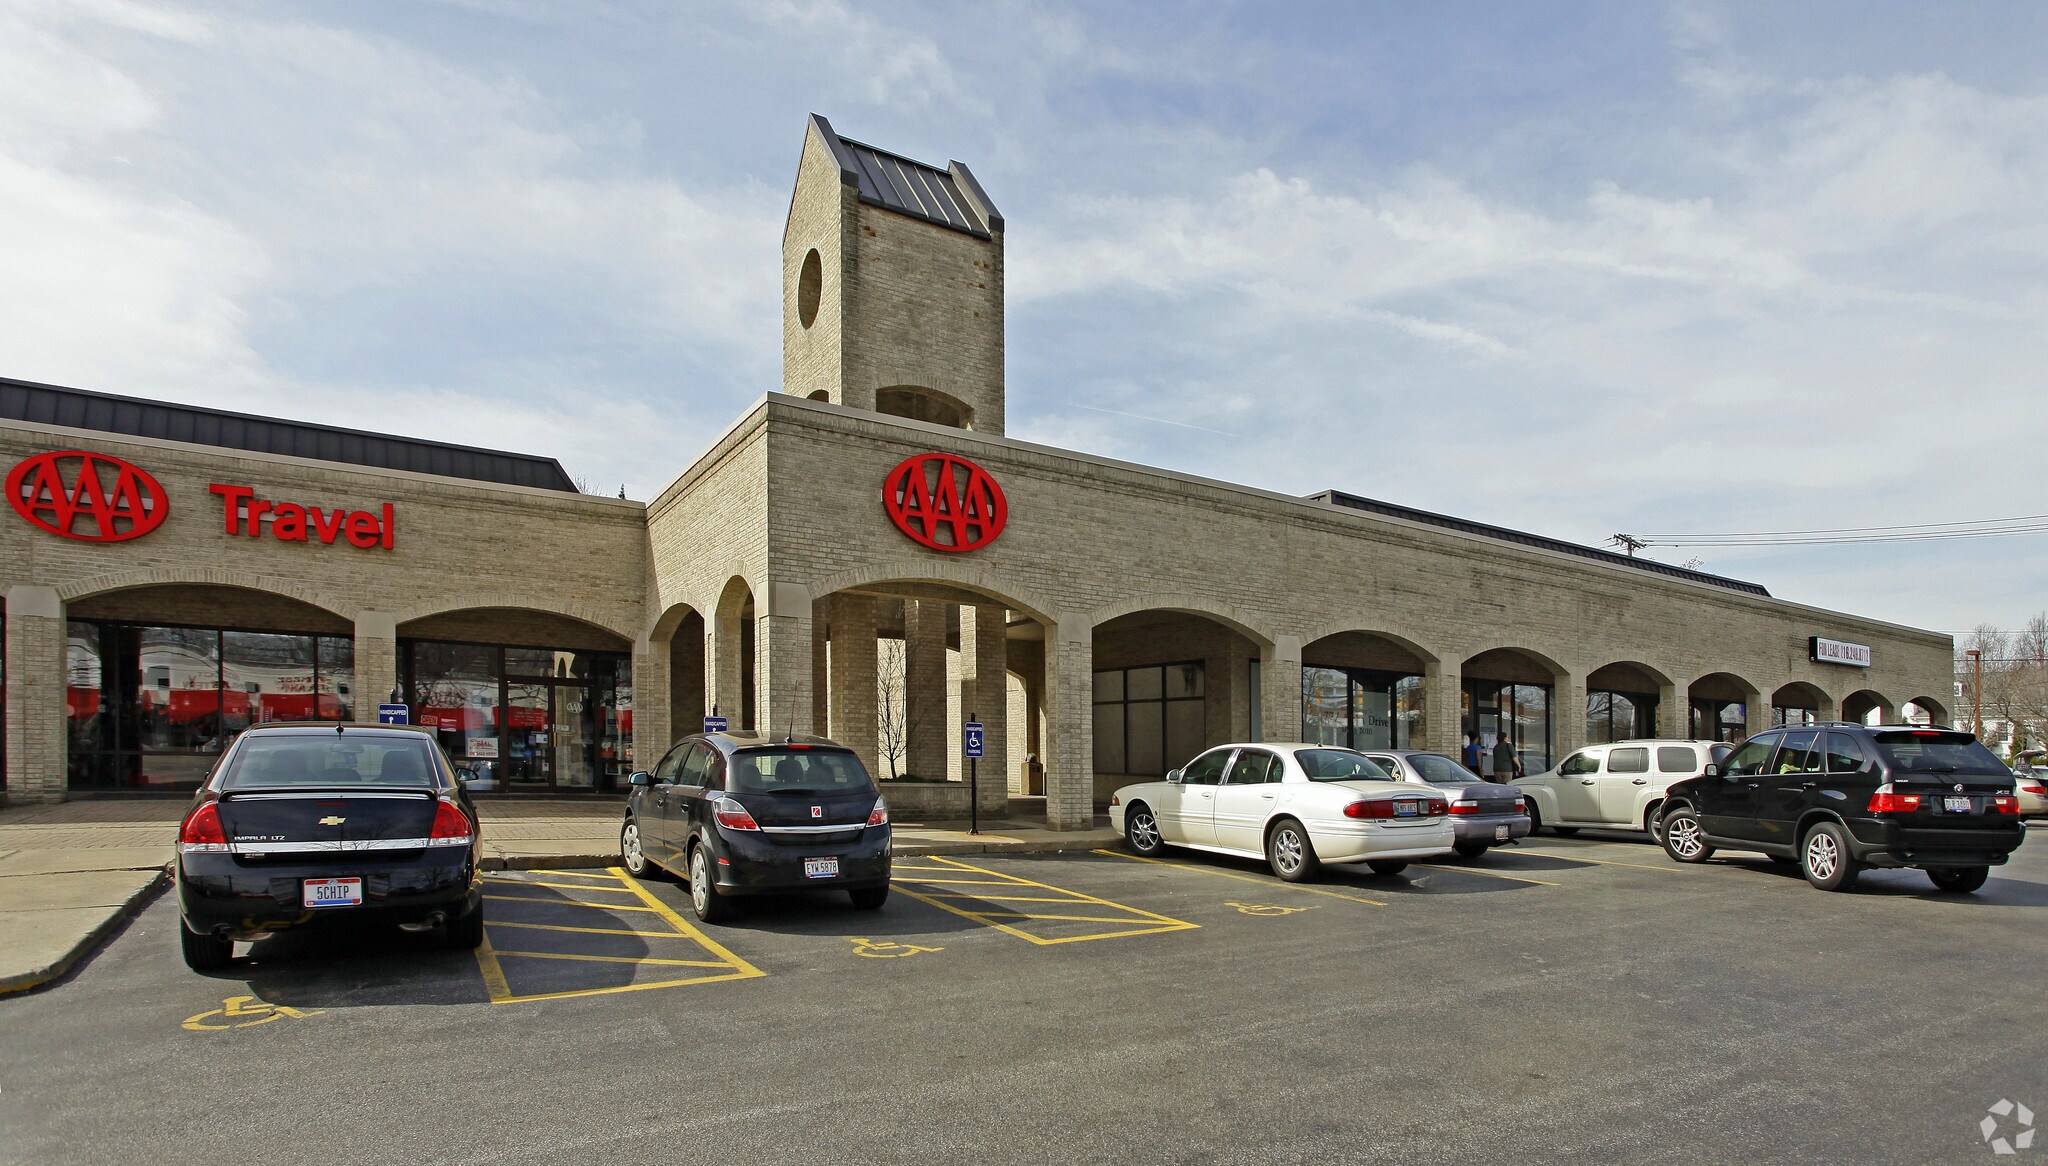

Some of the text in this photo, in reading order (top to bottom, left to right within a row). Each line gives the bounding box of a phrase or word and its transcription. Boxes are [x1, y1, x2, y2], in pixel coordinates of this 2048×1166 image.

[20, 450, 395, 550] AAA Travel
[894, 455, 998, 550] AAA
[1369, 714, 1389, 727] Drive
[317, 885, 350, 900] 5CHIP
